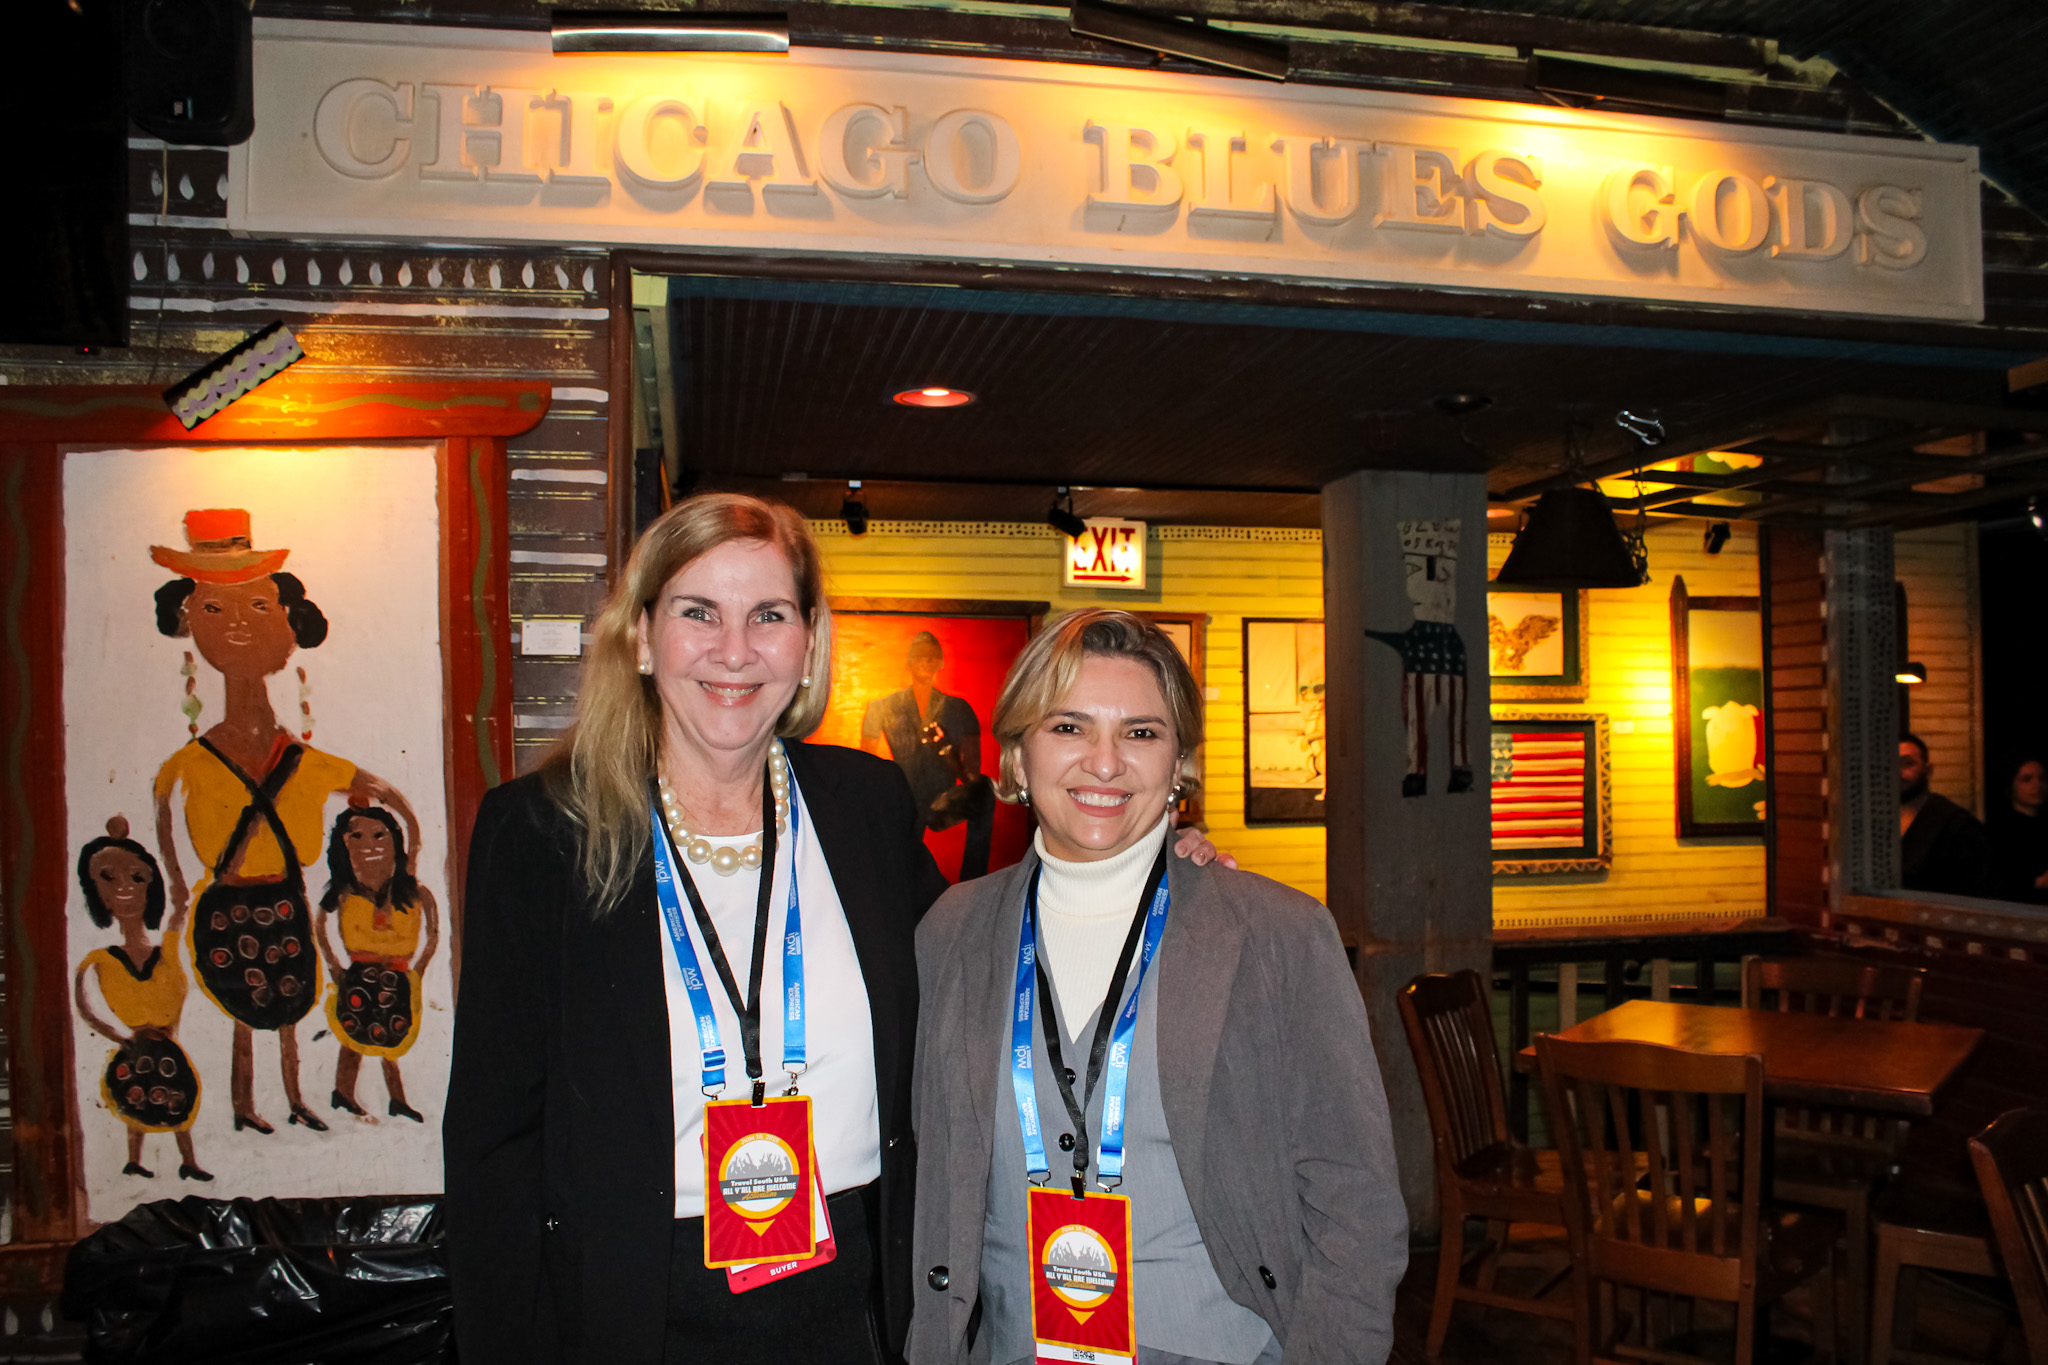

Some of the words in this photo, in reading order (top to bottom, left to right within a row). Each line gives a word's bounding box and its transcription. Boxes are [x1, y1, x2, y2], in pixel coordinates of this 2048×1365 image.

[314, 77, 1021, 206] CHICAGO
[1083, 117, 1546, 240] BLUES
[1604, 164, 1929, 272] GODS
[1073, 526, 1137, 572] EXIT
[666, 907, 682, 942] AMERICAN
[672, 906, 686, 937] EXPRESS
[699, 1016, 710, 1048] MERICAN
[705, 1014, 716, 1047] XPRESS
[1021, 1102, 1033, 1137] EXPRESS
[1026, 1096, 1038, 1136] AMERICAN
[1106, 1096, 1116, 1136] AMERICAN
[1112, 1096, 1121, 1131] EXPRESS
[722, 1187, 733, 1196] ALL
[753, 1184, 765, 1192] ARE
[766, 1182, 797, 1191] WELCOME
[731, 1179, 753, 1187] Travel
[753, 1177, 773, 1185] South
[770, 1261, 798, 1276] BUYER
[1053, 1265, 1073, 1274] Travel
[1074, 1268, 1093, 1276] South
[1093, 1270, 1107, 1278] USA
[1073, 1275, 1085, 1283] ARE
[1086, 1277, 1115, 1287] WELCOME
